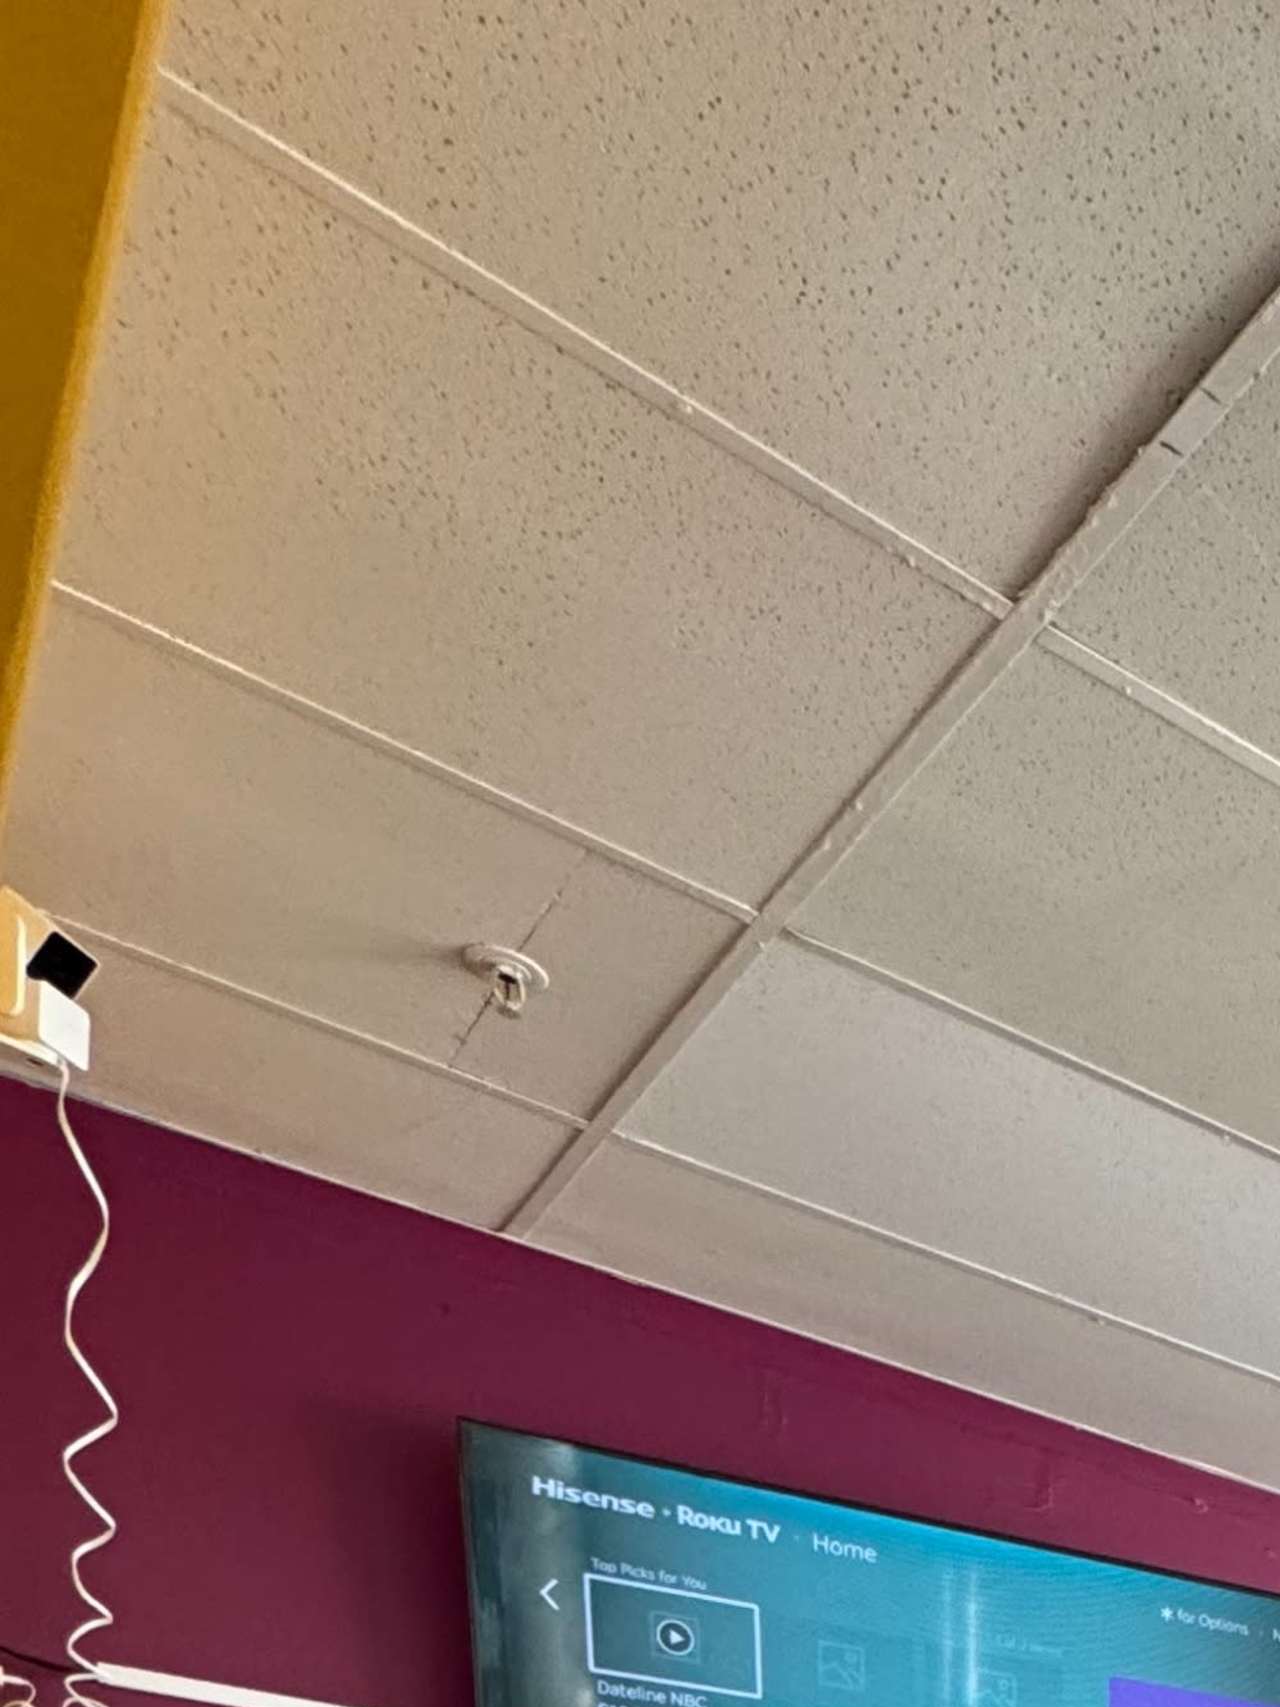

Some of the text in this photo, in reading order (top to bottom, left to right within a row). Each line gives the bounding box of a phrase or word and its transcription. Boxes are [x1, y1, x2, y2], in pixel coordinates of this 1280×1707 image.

[532, 1476, 877, 1563] Hisense Roku TV Home
[590, 1557, 707, 1590] Top Picks for You
[1178, 1608, 1195, 1624] for
[1199, 1613, 1248, 1636] Options
[597, 1680, 666, 1704] Dateline
